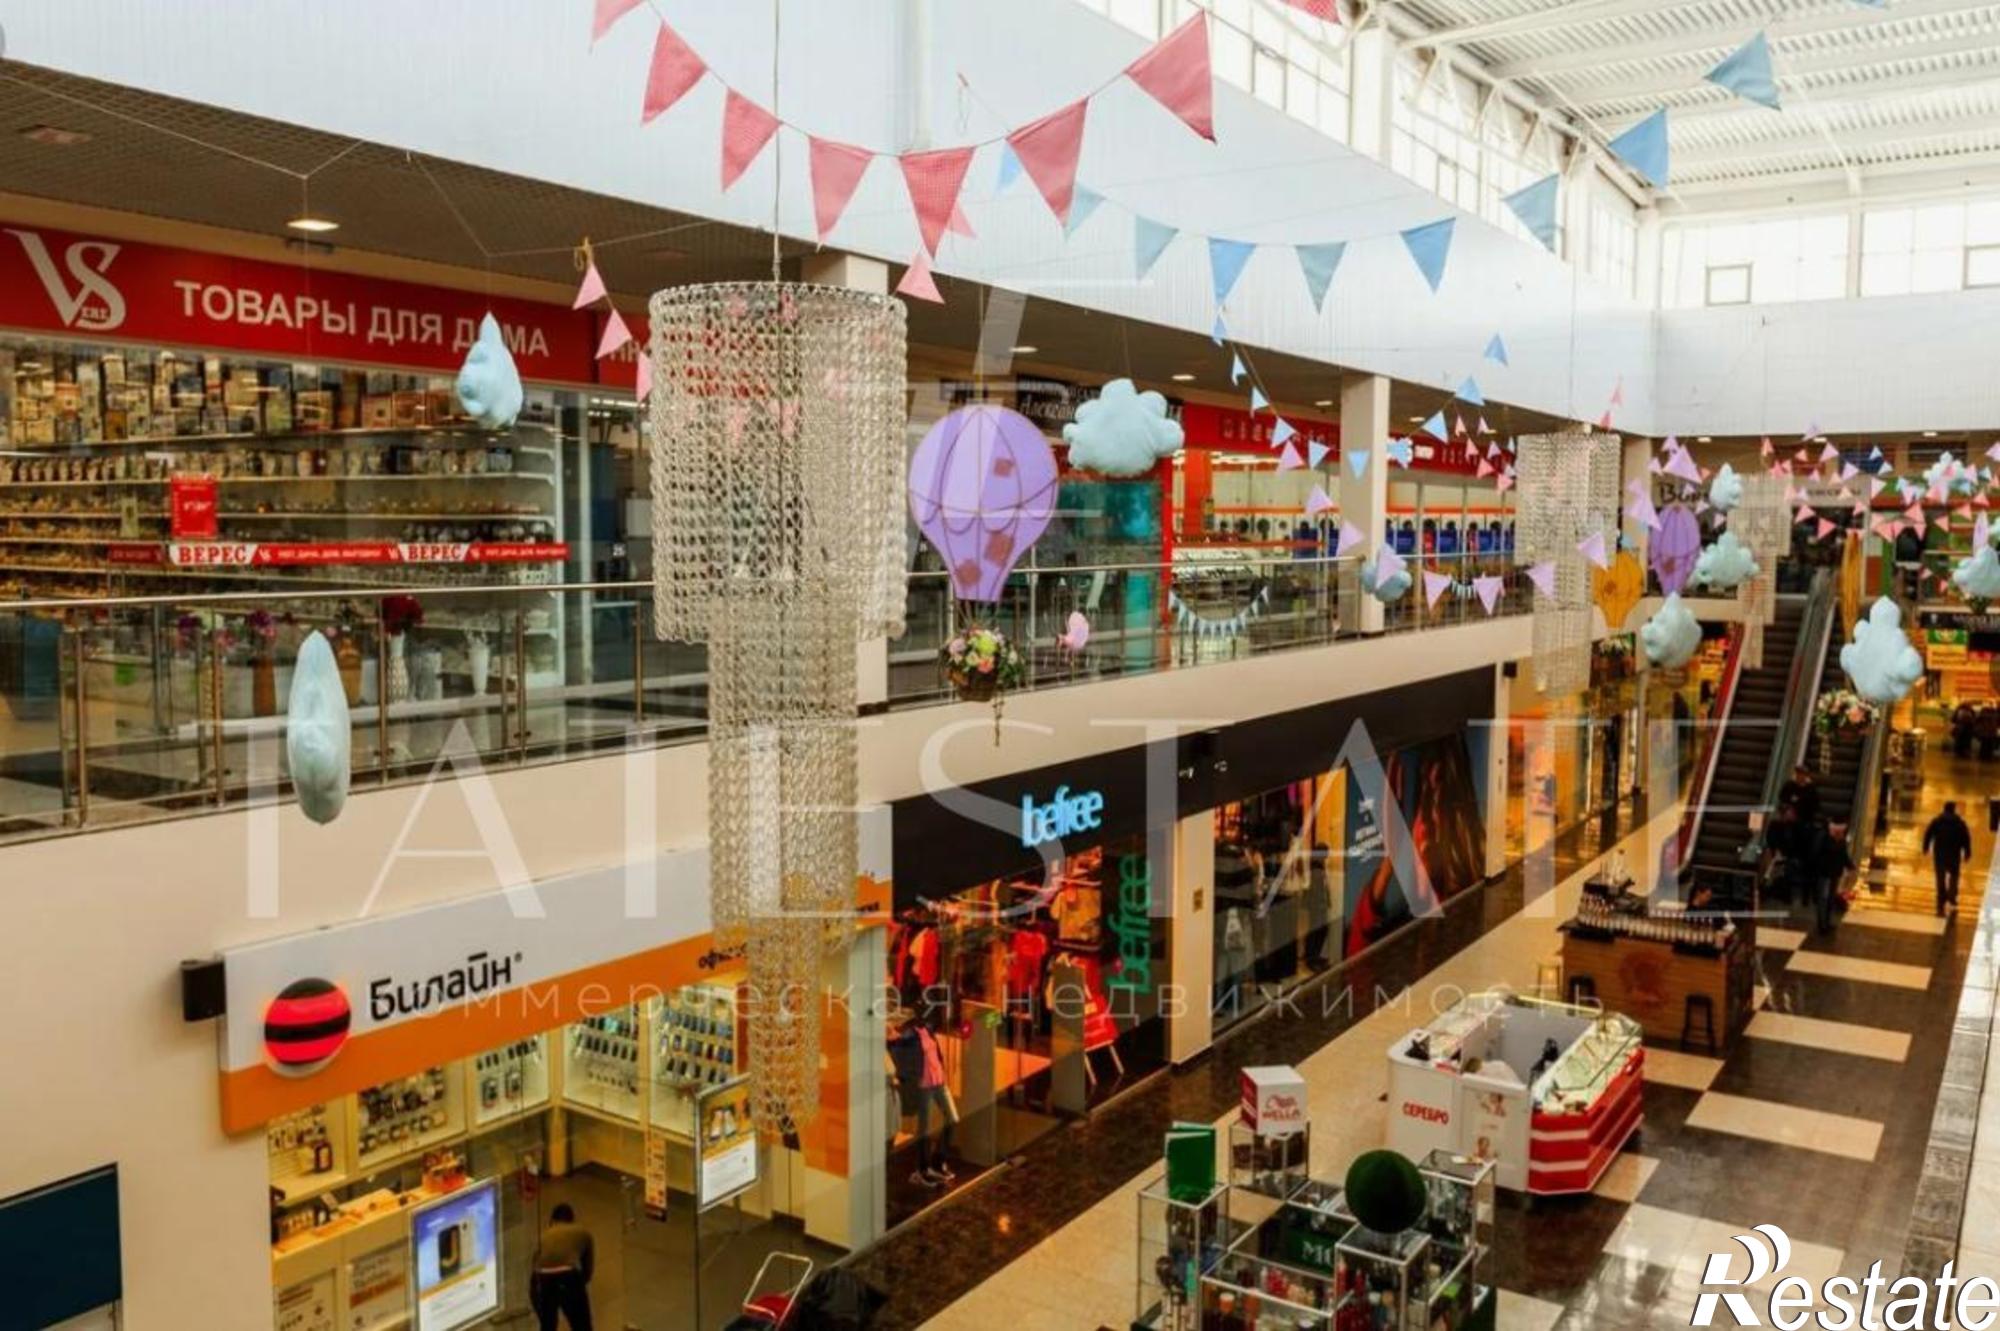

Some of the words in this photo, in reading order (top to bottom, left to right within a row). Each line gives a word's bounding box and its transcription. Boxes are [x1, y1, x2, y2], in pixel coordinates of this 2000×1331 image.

[173, 280, 356, 335] ТОВАРЫ
[367, 306, 443, 346] ДЛЯ
[452, 317, 550, 358] ДМА
[178, 546, 248, 564] ВЕРЕС
[408, 544, 462, 563] ВЕРЕС
[1022, 785, 1104, 847] befree
[1106, 853, 1151, 993] befree
[369, 951, 512, 1021] Билайн
